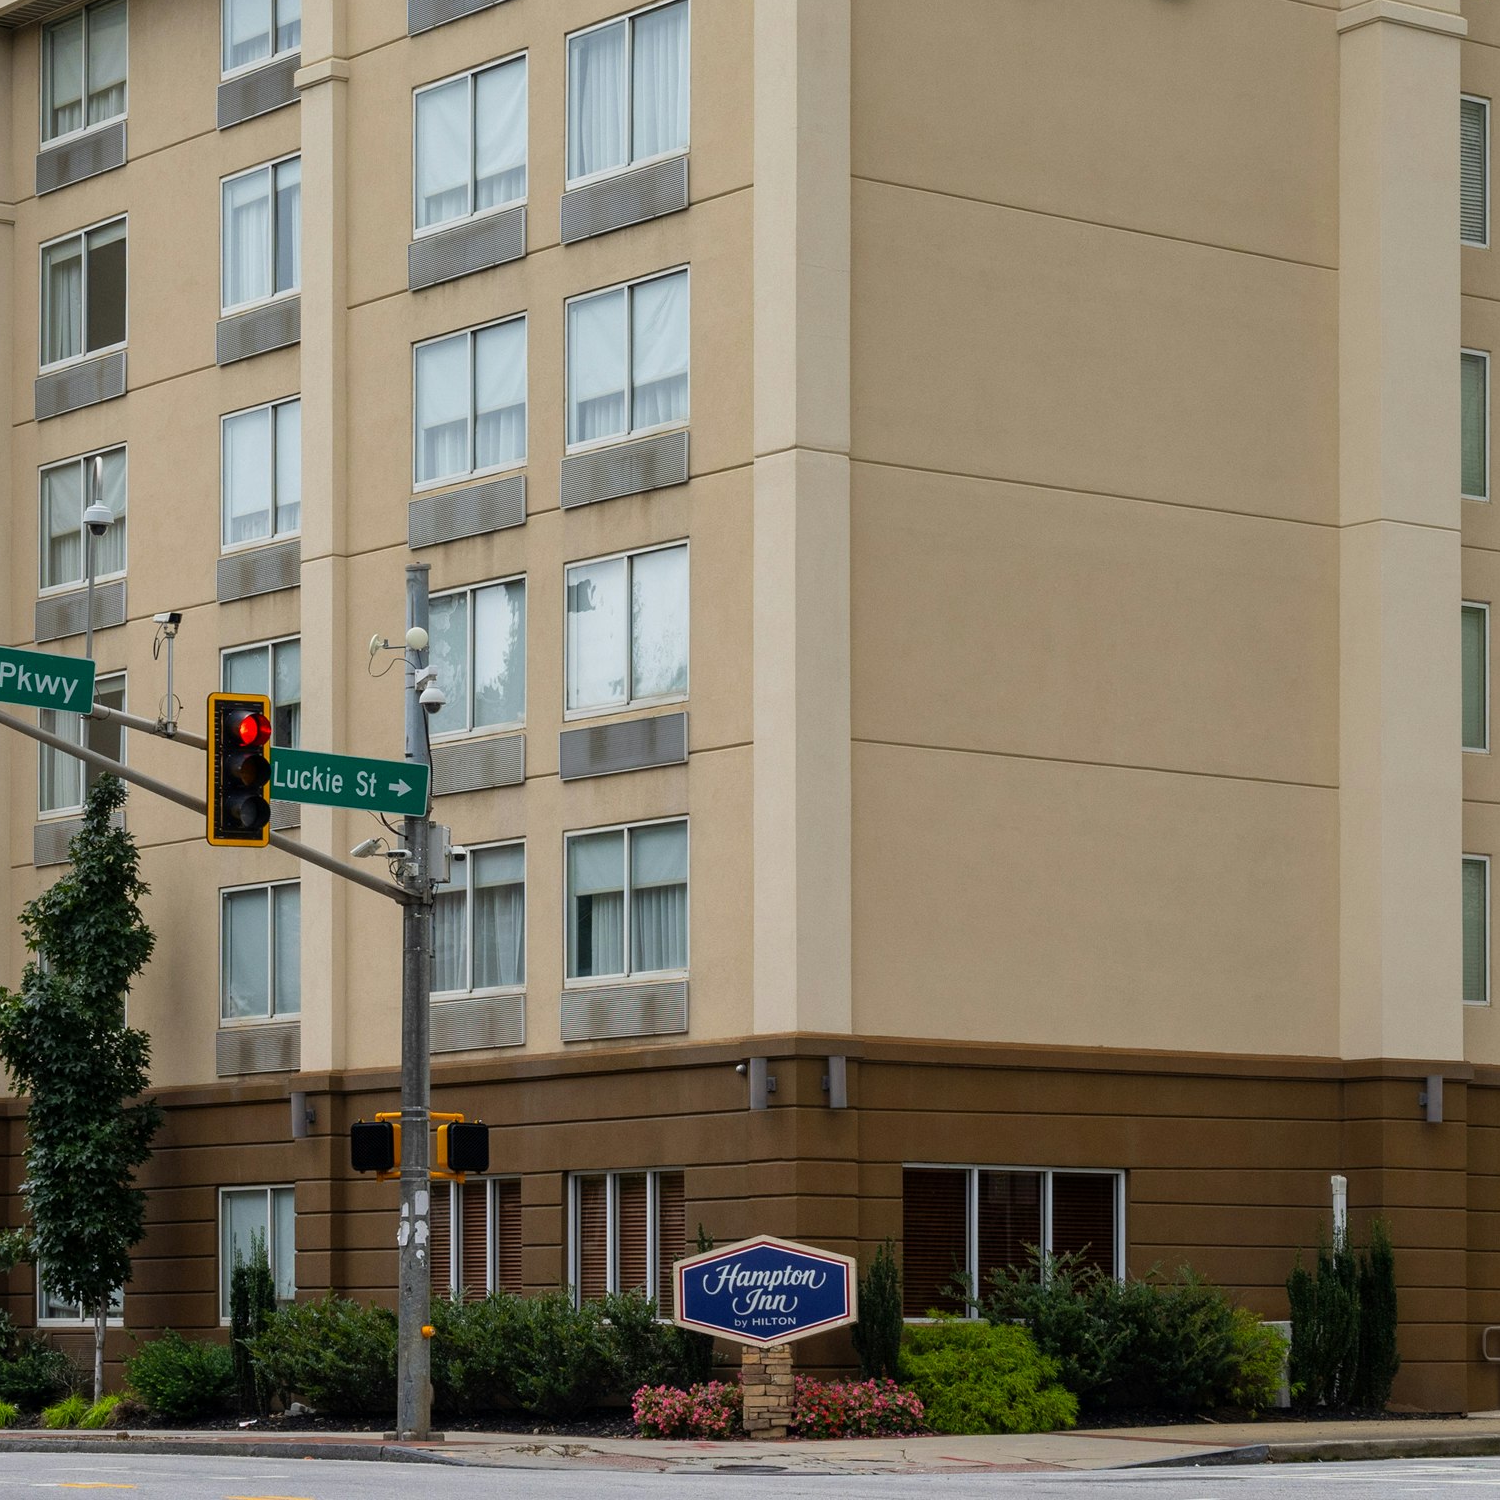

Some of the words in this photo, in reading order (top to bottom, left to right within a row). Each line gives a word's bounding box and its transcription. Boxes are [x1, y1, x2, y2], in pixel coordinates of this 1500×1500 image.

[273, 761, 343, 794] Luckie
[355, 770, 377, 798] St
[703, 1262, 827, 1295] Hampton
[732, 1288, 798, 1316] Inn
[734, 1318, 748, 1328] by
[752, 1317, 797, 1326] HILTON
